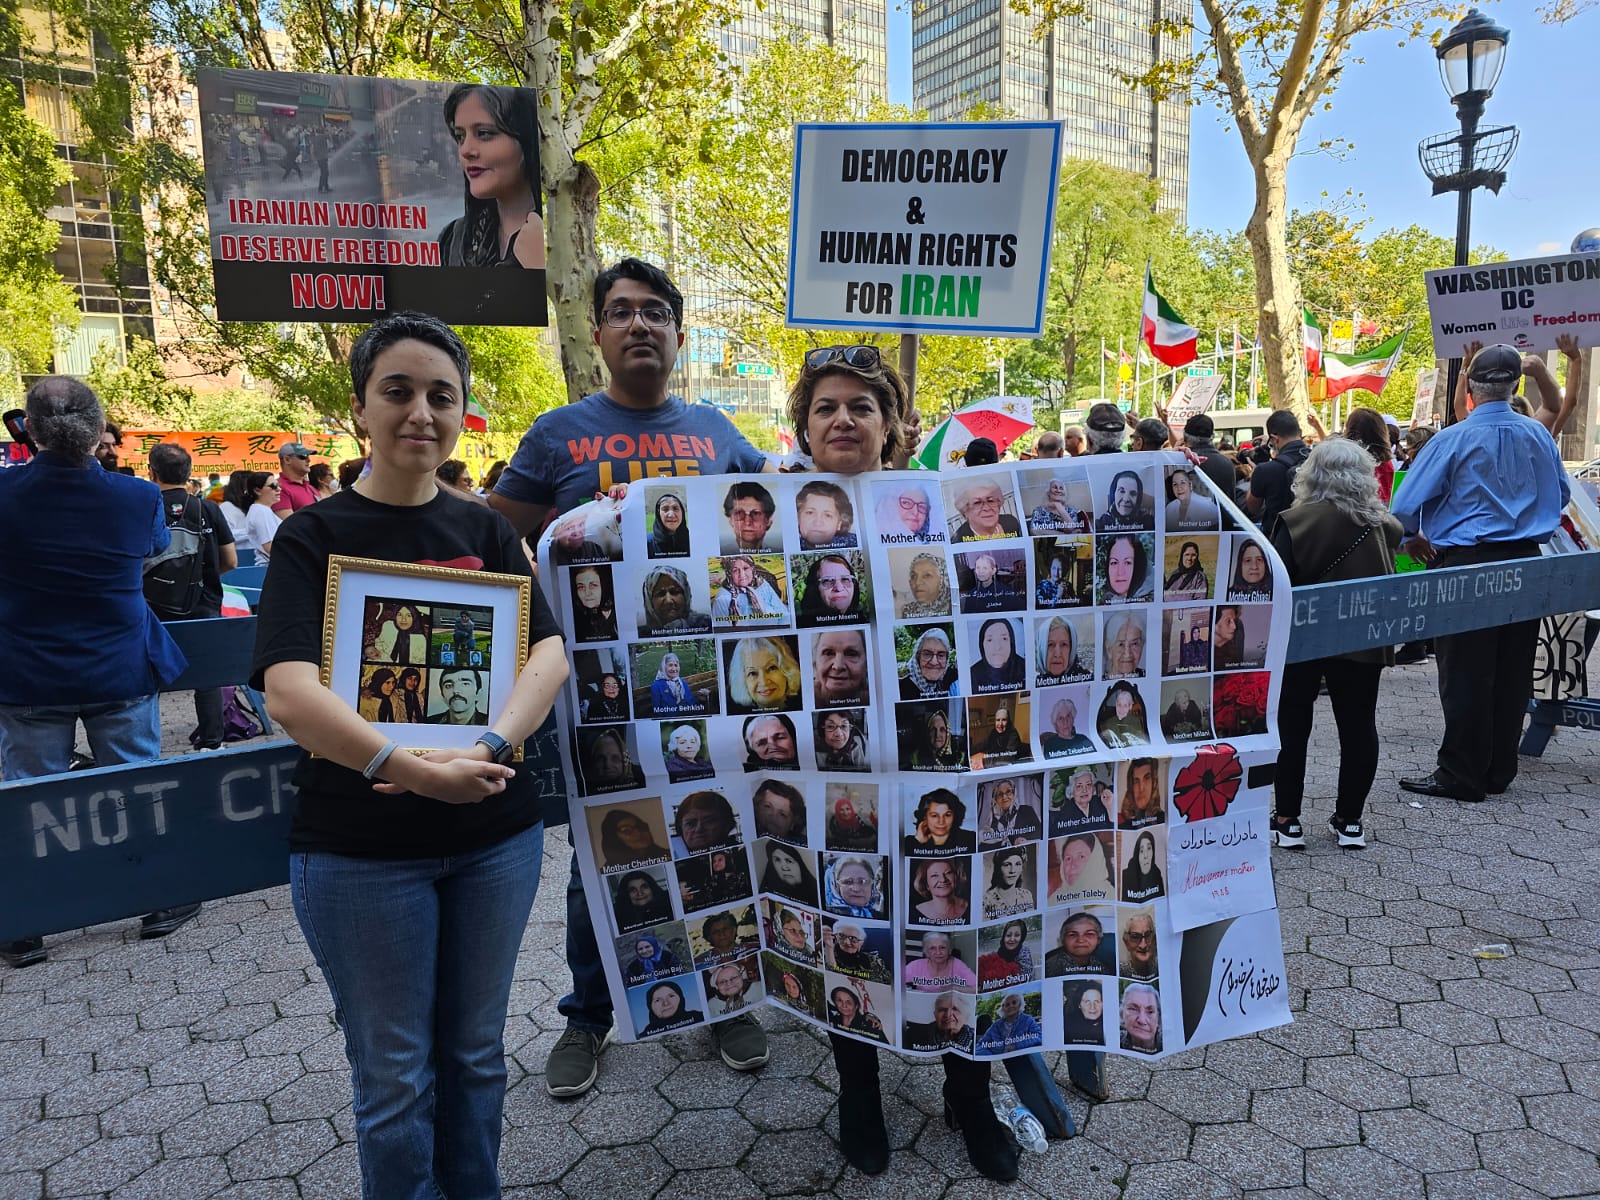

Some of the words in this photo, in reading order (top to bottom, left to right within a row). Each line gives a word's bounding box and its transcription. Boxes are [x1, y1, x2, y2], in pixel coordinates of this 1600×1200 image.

[841, 149, 1008, 183] DEMOCRACY
[228, 198, 330, 227] IRANIAN
[334, 202, 427, 230] WOMEN
[906, 196, 925, 225] &
[220, 235, 327, 263] DESERVE
[331, 238, 441, 267] FREEDOM
[819, 230, 912, 265] HUMAN
[917, 233, 1018, 268] RIGHTS
[1433, 258, 1600, 296] WASHINGTON
[290, 273, 386, 310] NOW!
[846, 281, 894, 315] FOR
[900, 274, 982, 318] IRAN
[1502, 289, 1535, 311] DC
[1441, 321, 1496, 336] Woman
[1533, 311, 1600, 327] Freedom
[567, 433, 716, 465] WOMEN
[191, 461, 236, 473] ompassion
[880, 533, 916, 544] Mother
[917, 533, 945, 543] Yazdi
[962, 534, 991, 542] Mother
[1228, 592, 1251, 602] Mother
[1293, 596, 1320, 627] CE
[1337, 589, 1378, 620] LINE
[1407, 580, 1429, 609] DO
[1436, 575, 1469, 605] NOT
[1474, 567, 1522, 598] CROSS
[715, 614, 747, 622] mother
[749, 612, 784, 620] Nikokar
[1367, 614, 1426, 641] NYPD
[978, 684, 1000, 692] Mother
[1036, 677, 1059, 687] Mother
[1562, 709, 1600, 728] POL
[30, 780, 180, 858] NOT
[1057, 819, 1081, 830] Mother
[984, 830, 1007, 840] Mother
[1180, 827, 1217, 850] خاوران
[1222, 820, 1258, 847] مادران
[913, 847, 933, 856] Mother
[602, 862, 630, 874] Mother
[1056, 892, 1080, 903] Mother
[1081, 888, 1107, 899] Taleby
[630, 972, 653, 984] Mother
[913, 977, 934, 986] Mother
[983, 978, 1005, 990] Mother
[1005, 972, 1030, 984] Shekary
[913, 1043, 939, 1051] Mother
[981, 1039, 1004, 1048] Mother
